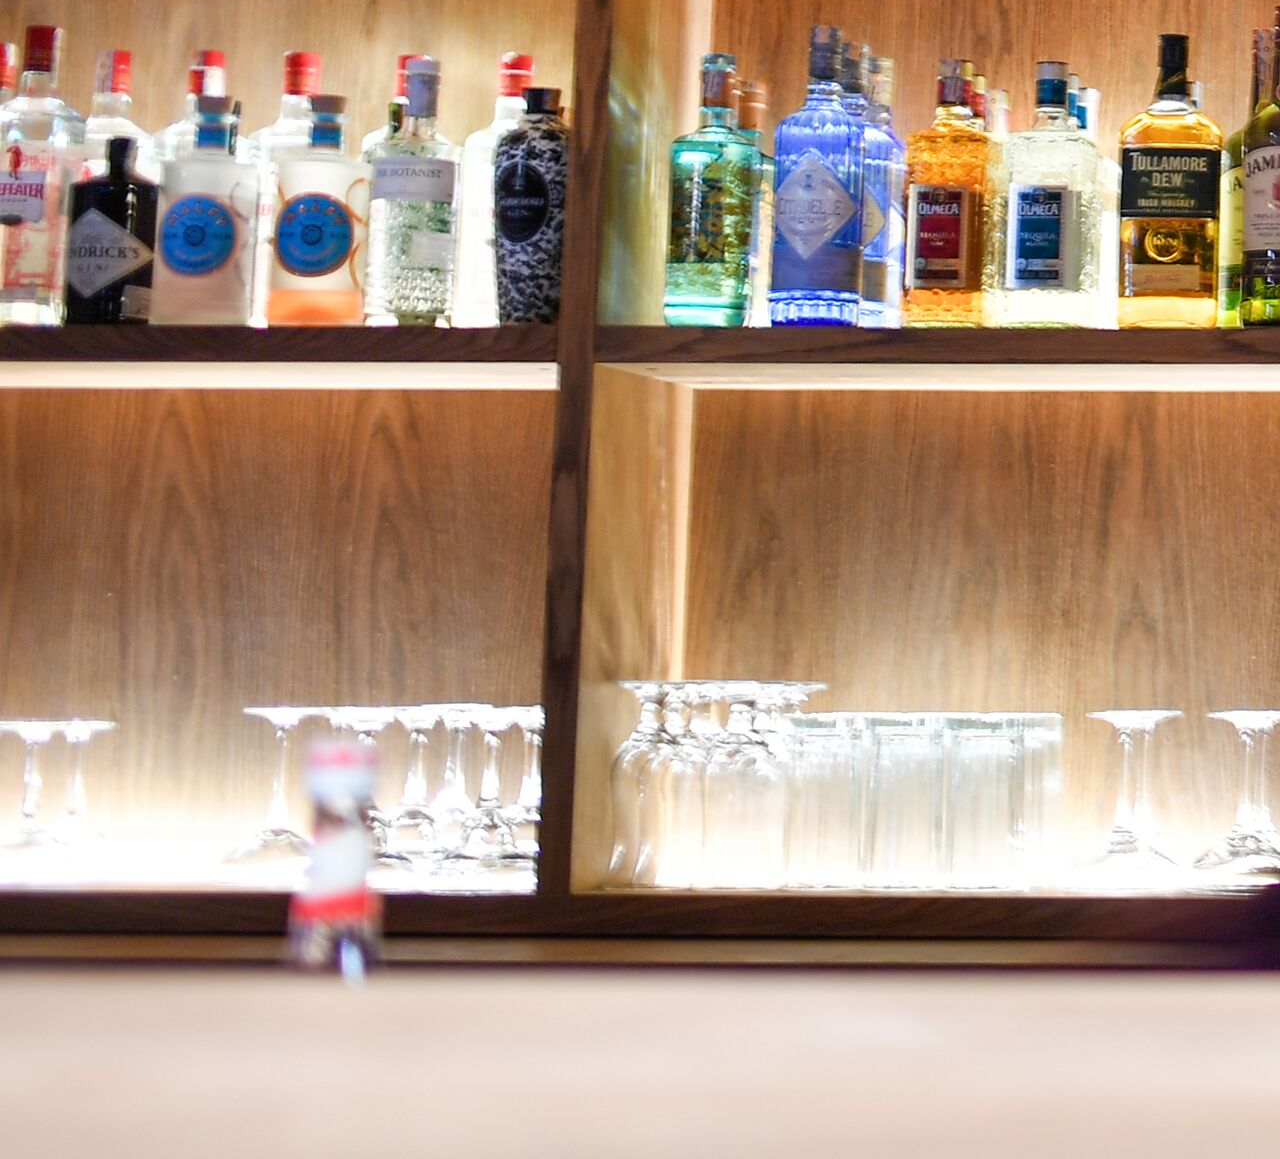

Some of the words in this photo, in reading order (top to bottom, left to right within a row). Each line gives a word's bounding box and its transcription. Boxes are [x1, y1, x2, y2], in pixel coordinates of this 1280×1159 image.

[1128, 150, 1208, 173] TULLAMORE
[389, 167, 443, 178] BOTANIST
[1152, 172, 1184, 188] DEW
[918, 202, 960, 216] OLMECA
[1018, 202, 1059, 216] OLMECA
